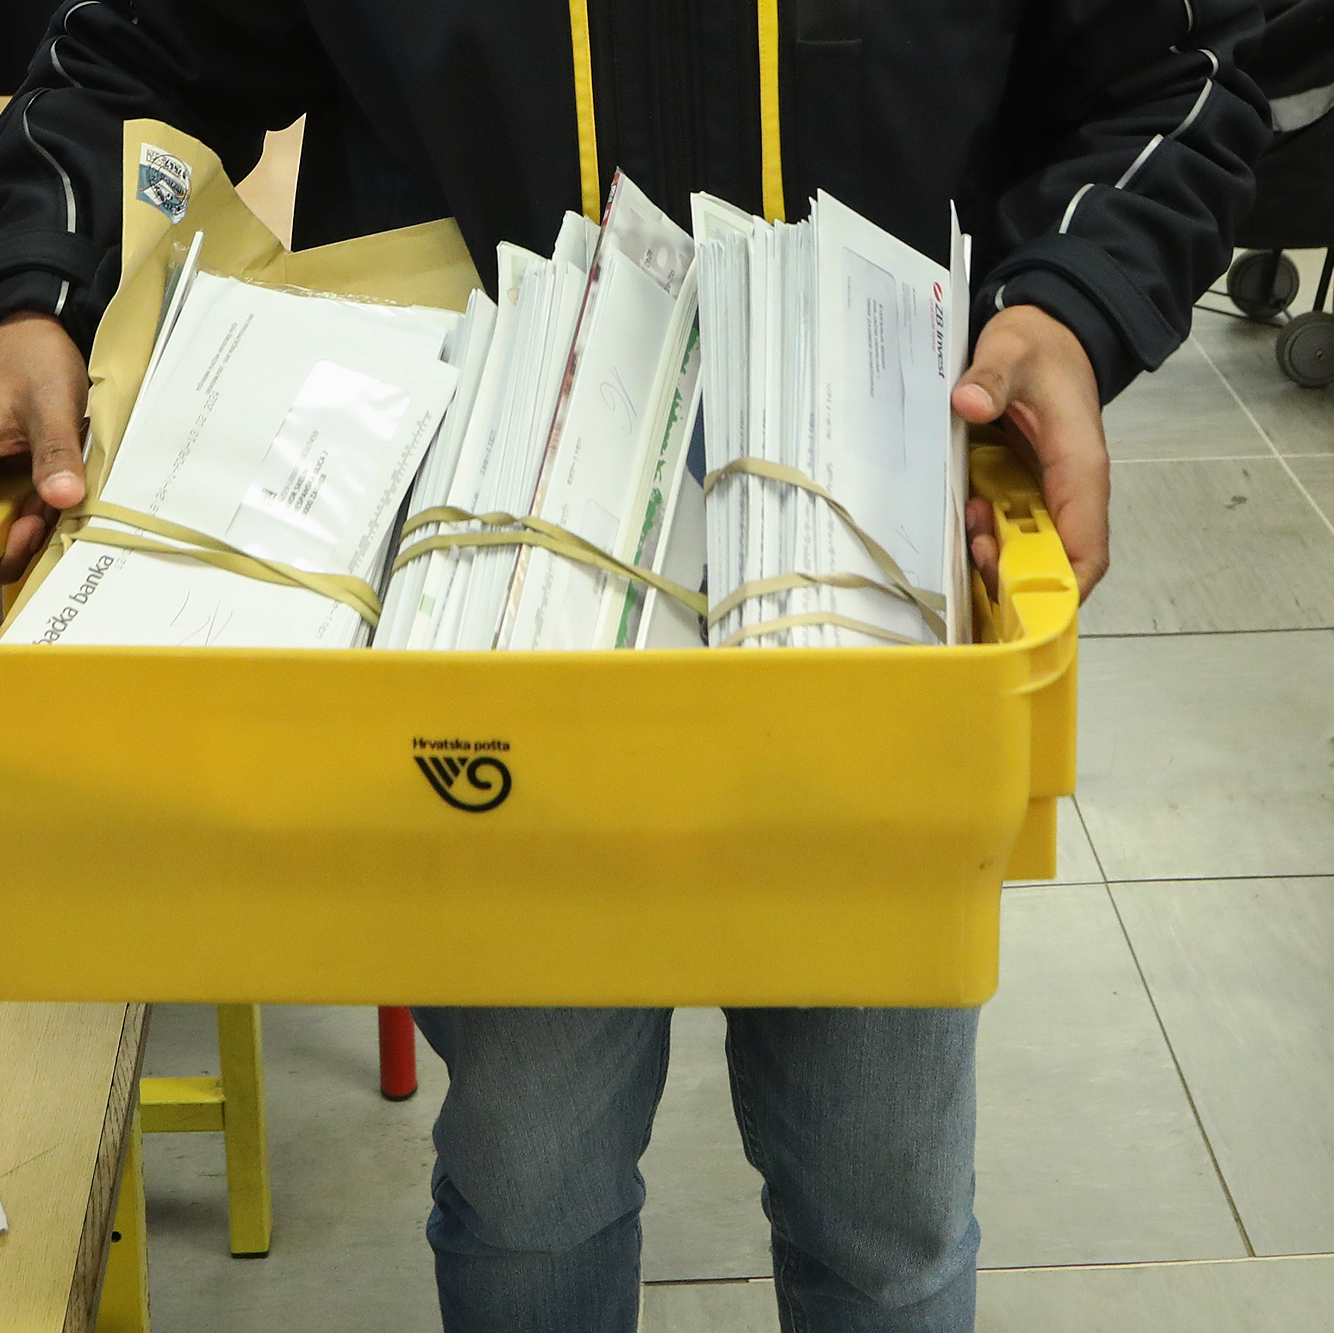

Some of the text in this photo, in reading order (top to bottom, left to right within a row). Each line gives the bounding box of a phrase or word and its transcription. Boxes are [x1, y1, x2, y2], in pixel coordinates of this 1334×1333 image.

[934, 302, 945, 379] ZB Invest
[68, 554, 114, 605] banka
[413, 738, 510, 752] Hrvatska pošta
